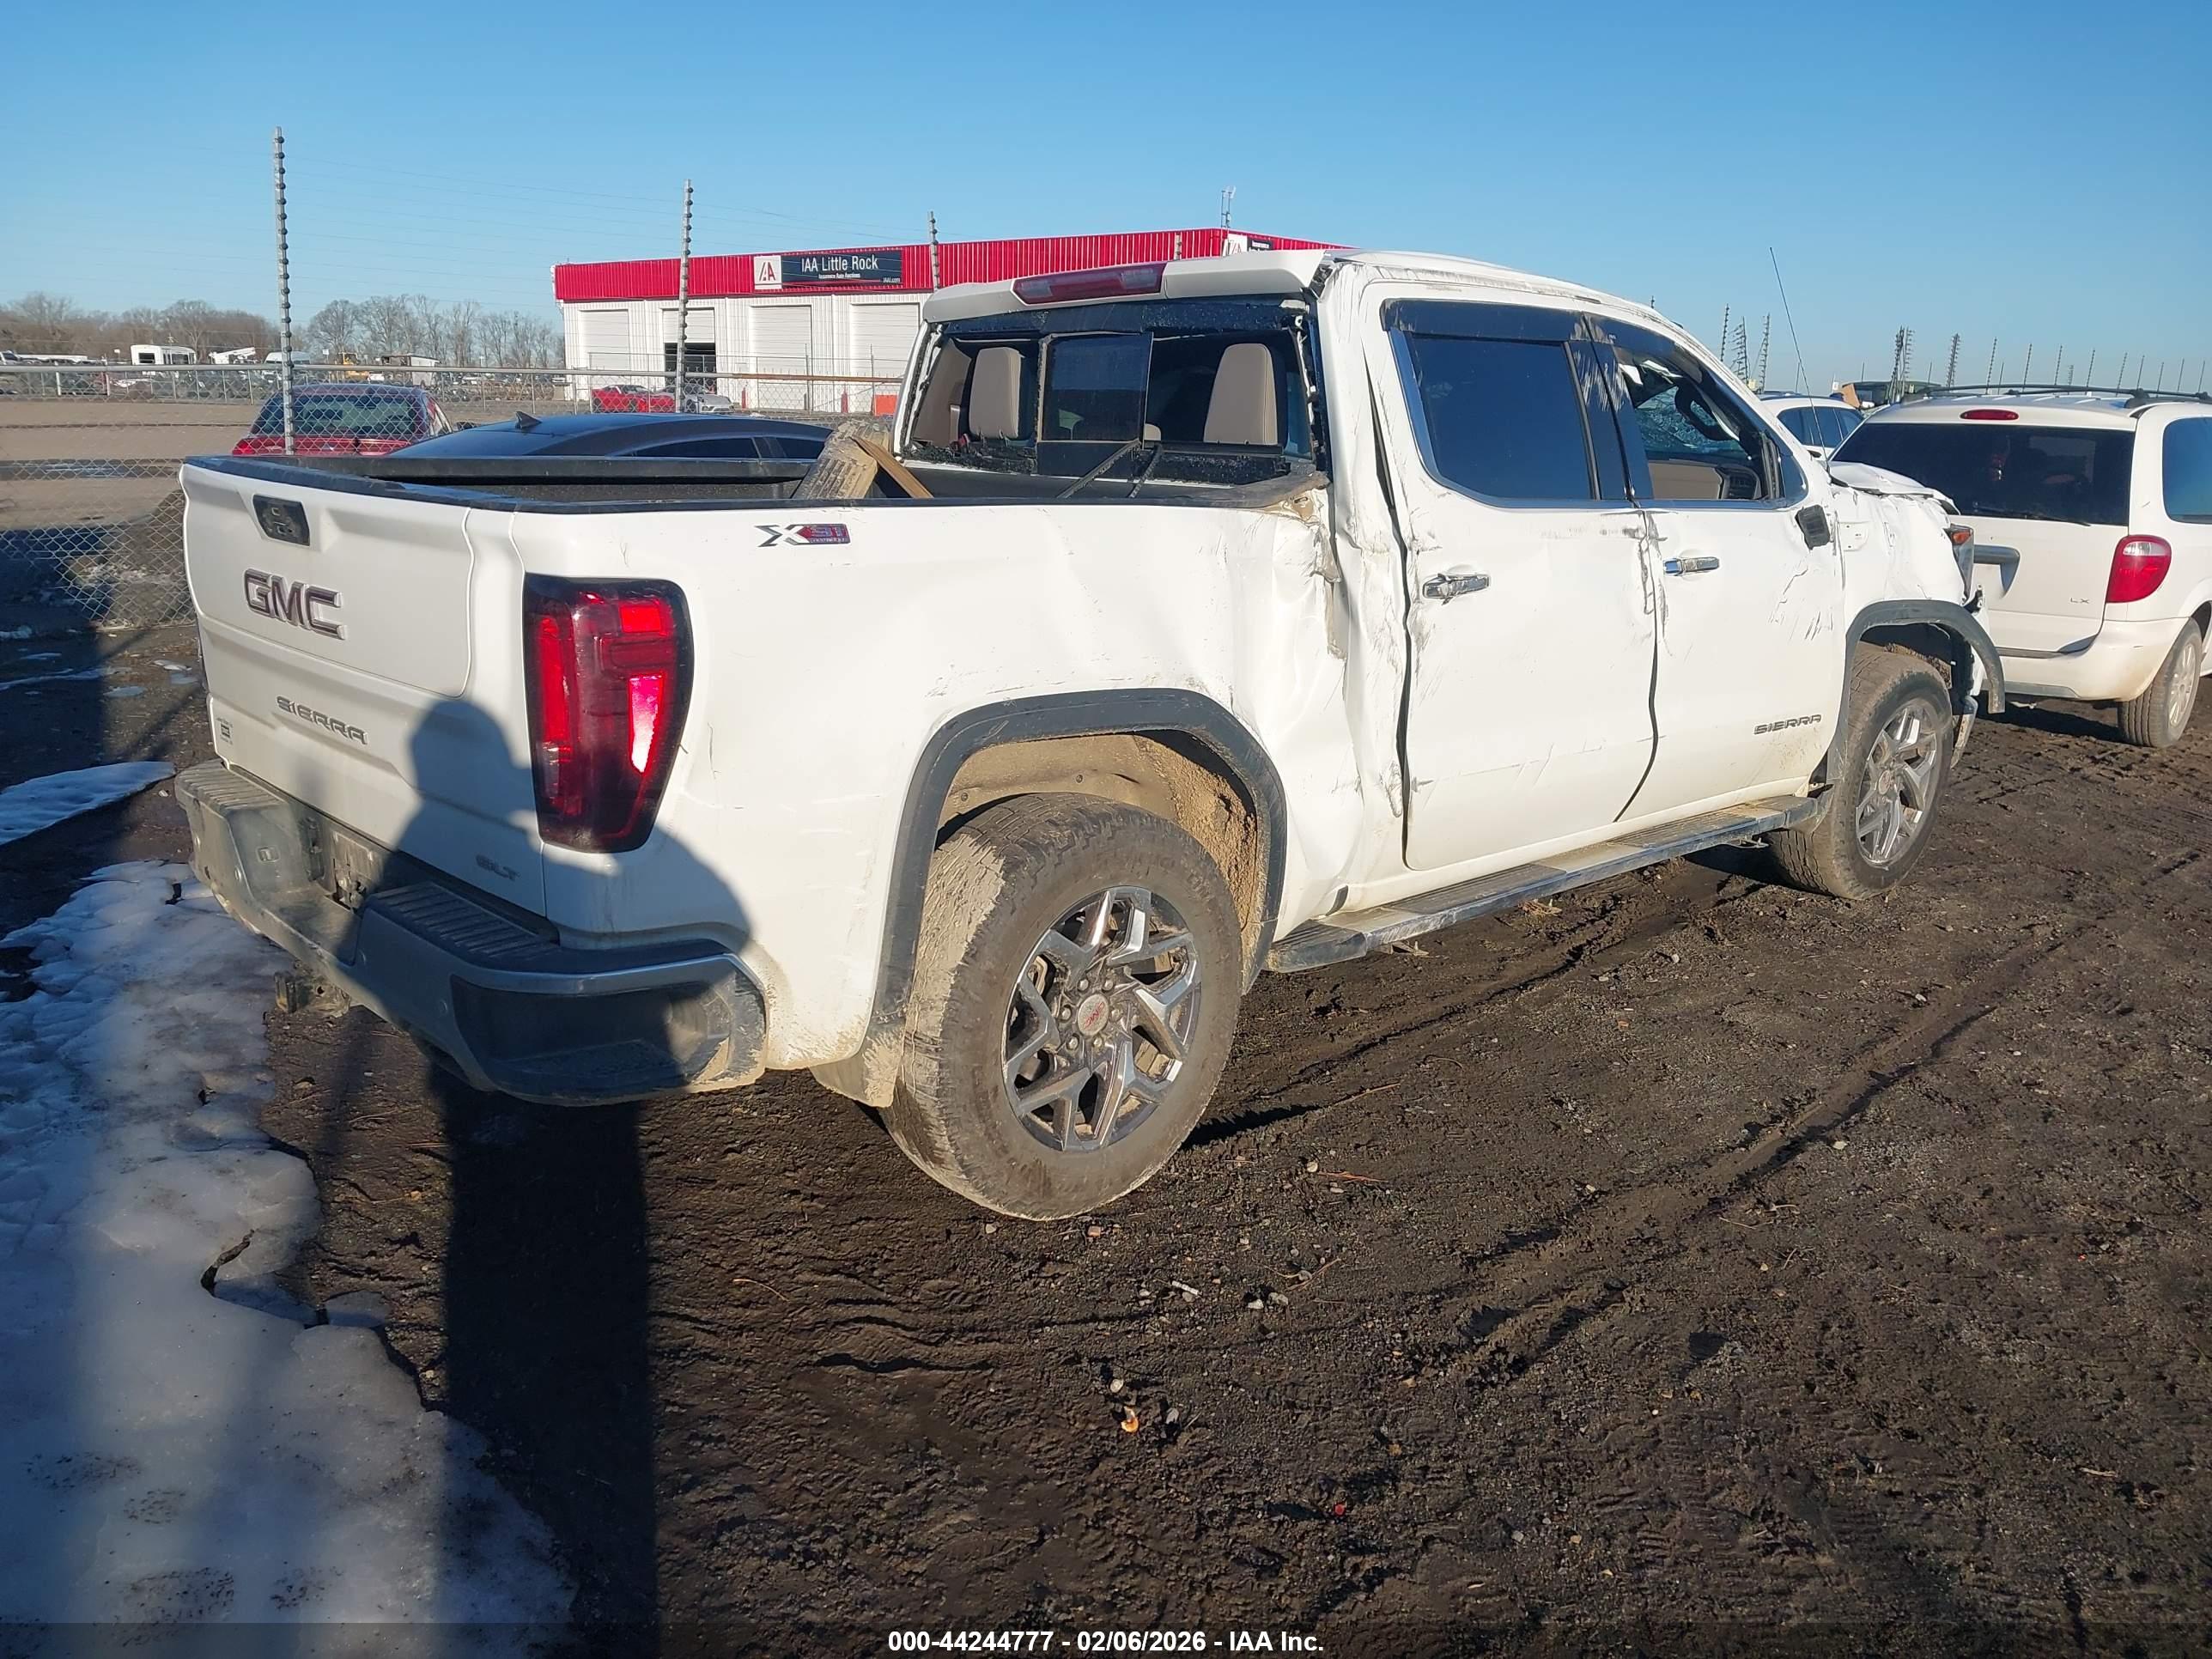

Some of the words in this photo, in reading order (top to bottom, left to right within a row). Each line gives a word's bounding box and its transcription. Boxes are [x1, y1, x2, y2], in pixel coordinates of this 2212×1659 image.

[802, 258, 818, 272] IAA
[822, 257, 848, 271] Little
[852, 254, 878, 270] Rock
[244, 568, 348, 640] GMC
[276, 696, 368, 744] SIERRA
[1753, 714, 1822, 735] SIERRA
[476, 854, 521, 882] SLT
